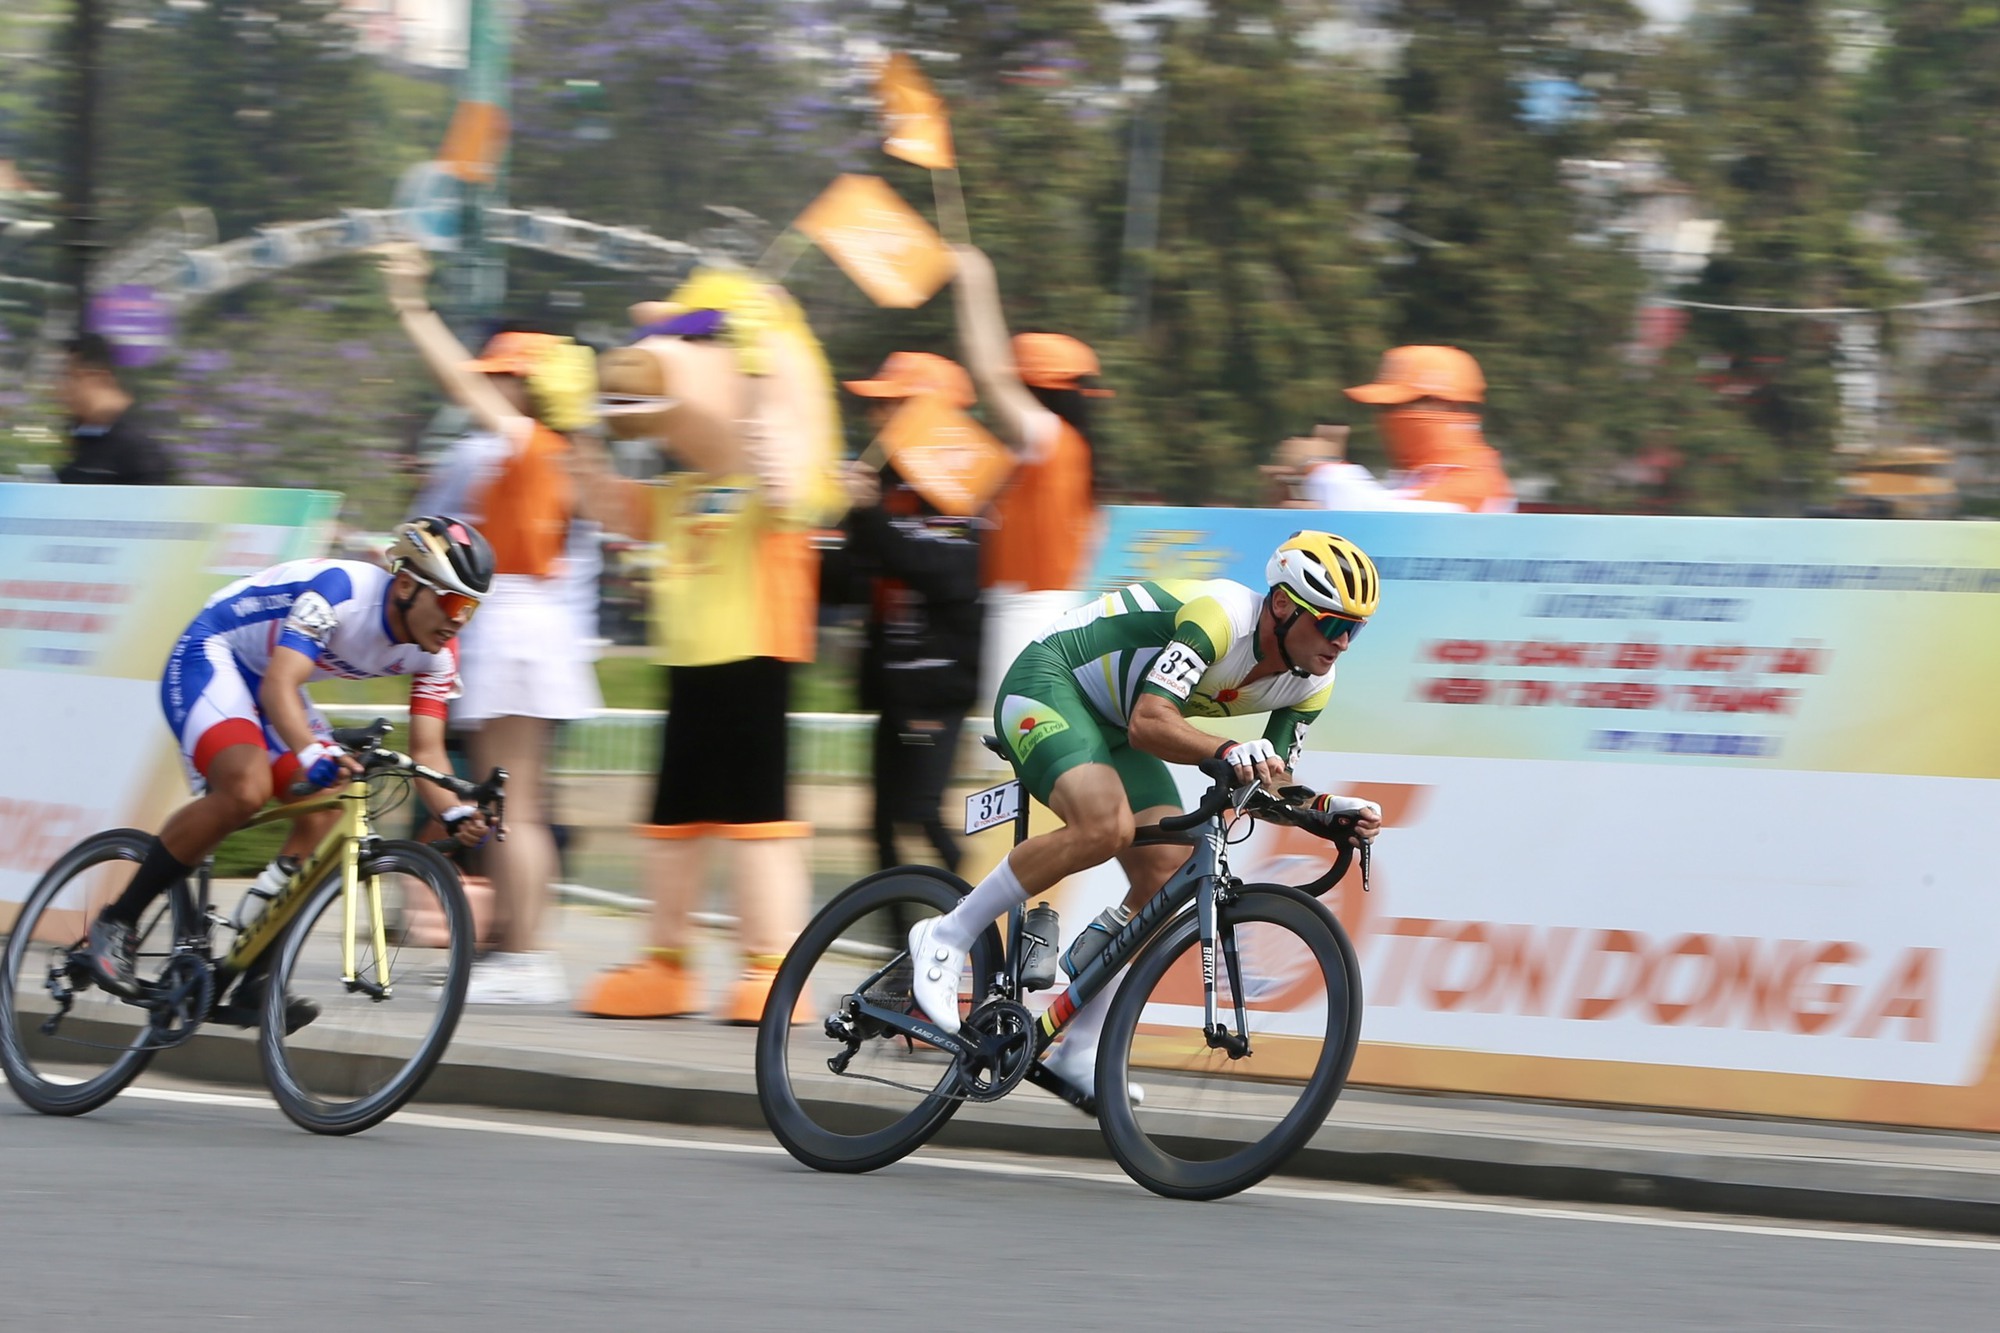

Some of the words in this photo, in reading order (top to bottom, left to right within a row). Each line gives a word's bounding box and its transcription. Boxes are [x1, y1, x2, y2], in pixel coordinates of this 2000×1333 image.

[1160, 650, 1196, 681] 37
[980, 788, 1006, 820] 37
[1102, 887, 1169, 968] BRIXIA
[1202, 946, 1212, 985] BRIXIA
[1366, 916, 1588, 1018] TON
[1563, 928, 1868, 1035] DONG
[1842, 945, 1945, 1043] A
[911, 1025, 932, 1039] LAND
[933, 1035, 945, 1044] OF
